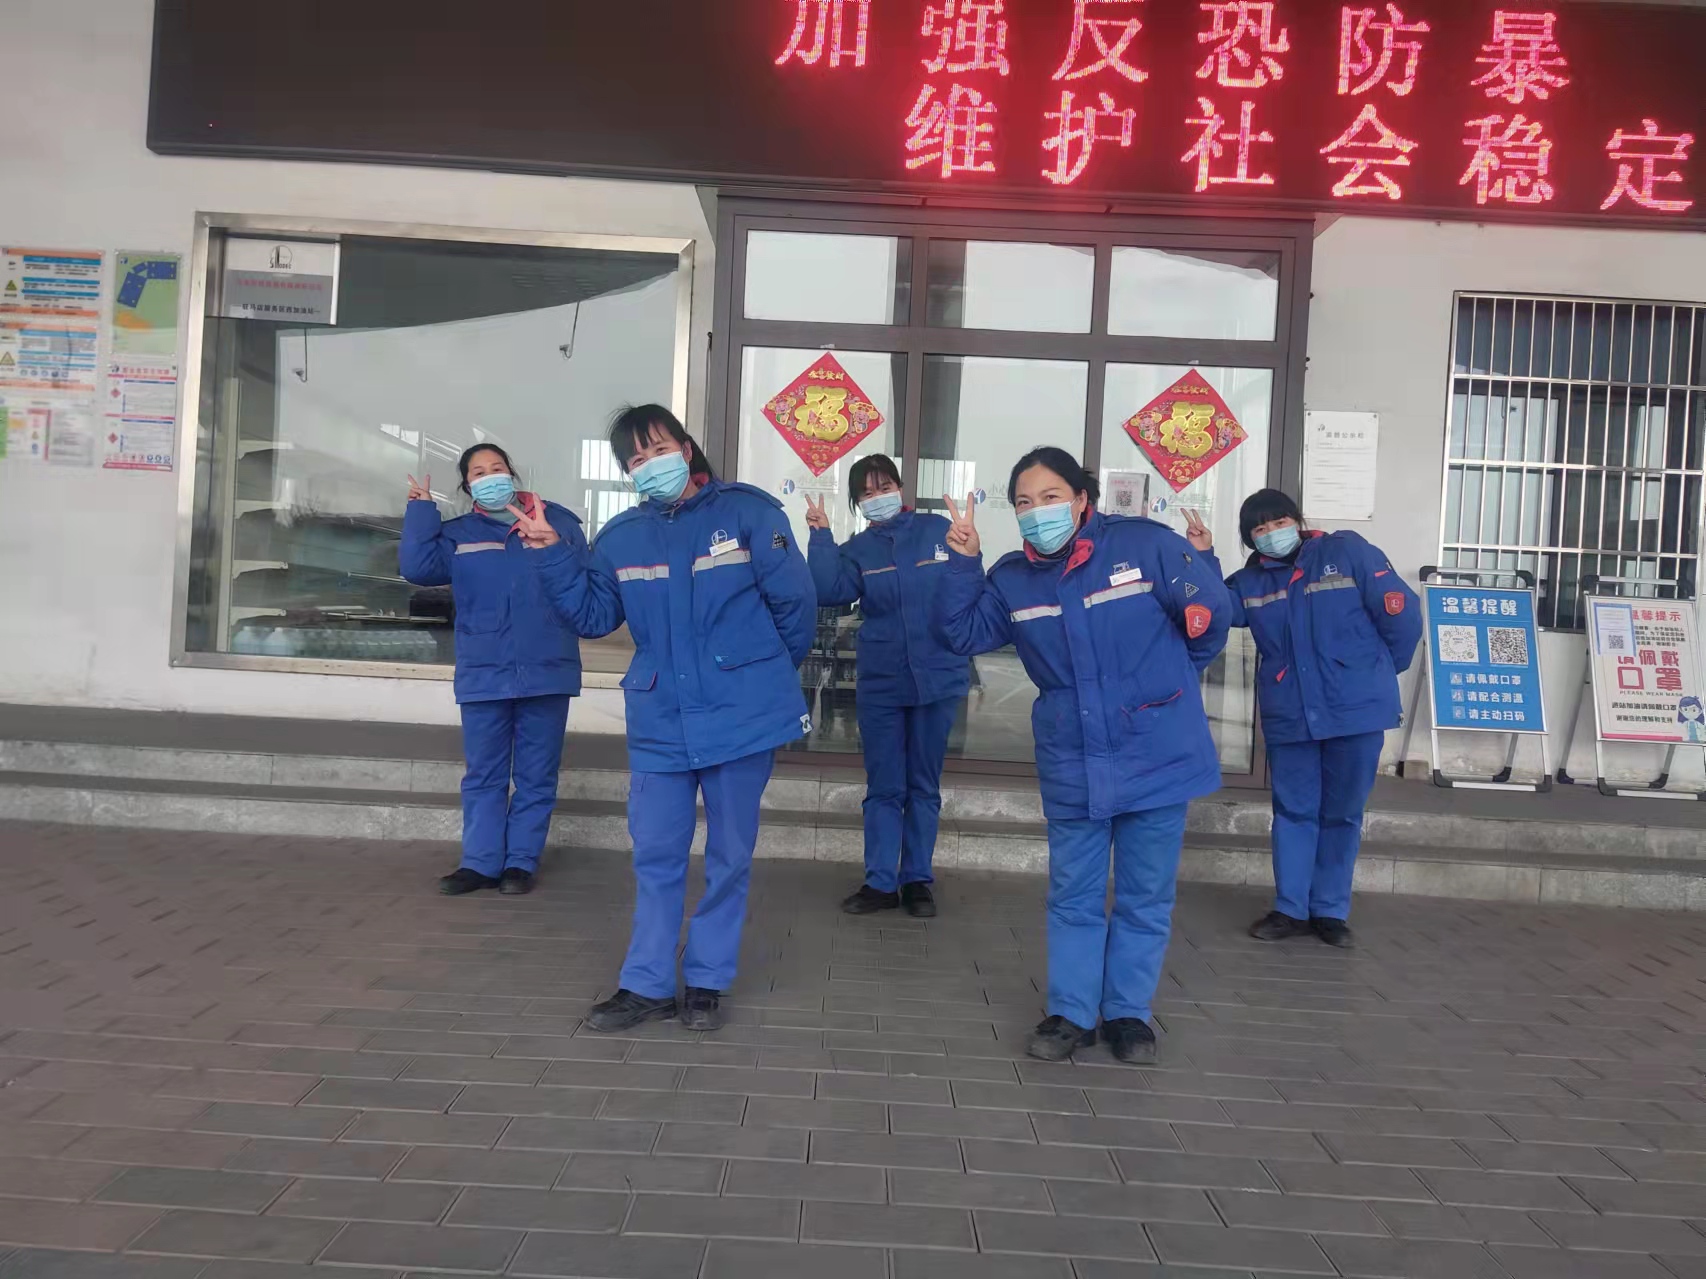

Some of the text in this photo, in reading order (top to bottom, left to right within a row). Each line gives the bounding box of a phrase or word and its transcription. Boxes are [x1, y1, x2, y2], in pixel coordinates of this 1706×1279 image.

[773, 0, 1571, 105] 加强反恐防暴
[904, 82, 1696, 213] 维护社会稳定
[794, 384, 849, 442] 福
[1159, 400, 1216, 458] 福
[1442, 597, 1518, 616] 温馨提醒
[1466, 673, 1521, 685] 请佩戴口罩
[1617, 666, 1683, 691] 口罩
[1467, 691, 1524, 704] 请配合测温
[1469, 708, 1525, 722] 请主动扫码
